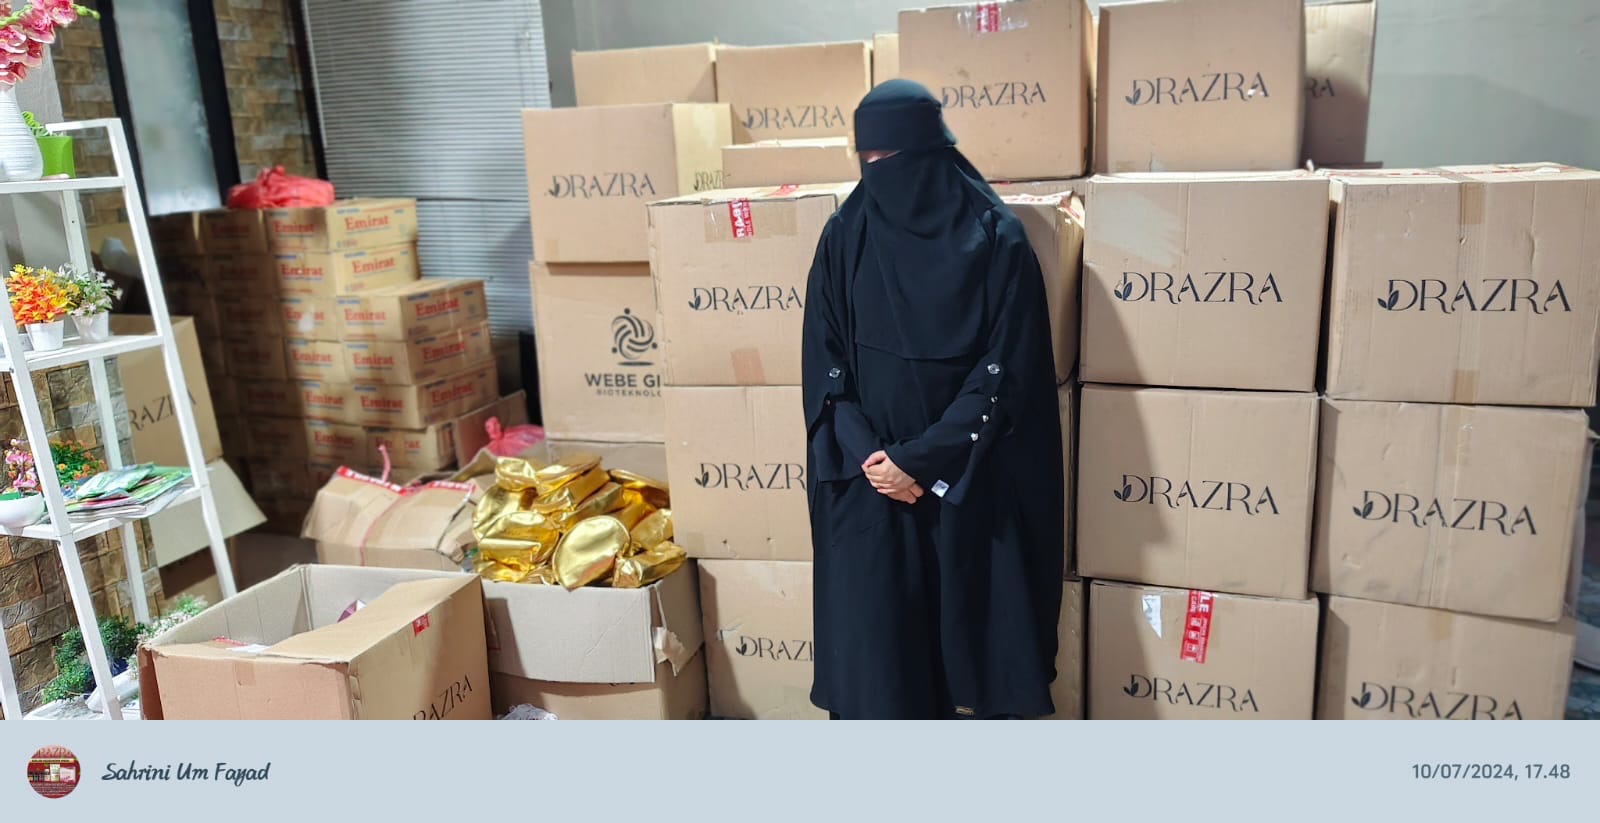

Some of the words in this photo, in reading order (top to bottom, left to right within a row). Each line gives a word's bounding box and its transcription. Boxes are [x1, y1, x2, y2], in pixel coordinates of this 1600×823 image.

[941, 79, 1047, 109] DRAZRA
[1125, 70, 1270, 107] DRAZRA
[742, 104, 846, 130] DRAZRA
[548, 172, 656, 199] DRAZRA
[344, 215, 390, 231] Emirat
[351, 257, 396, 274] Emirat
[688, 284, 803, 313] DRAZRA
[1114, 270, 1284, 306] DRAZRA
[1378, 277, 1572, 315] DRAZRA
[344, 309, 387, 322] Emirat
[415, 298, 461, 317] Emirat
[292, 350, 333, 363] Emirat
[353, 353, 395, 366] Emirat
[584, 372, 637, 388] WEBE
[361, 395, 404, 410] Emirat
[1114, 473, 1280, 516] DRAZRA
[1353, 489, 1538, 537] DRAZRA
[736, 635, 813, 662] DRAZ
[1123, 673, 1260, 713] DRAZRA
[1351, 681, 1523, 720] DRAZRA
